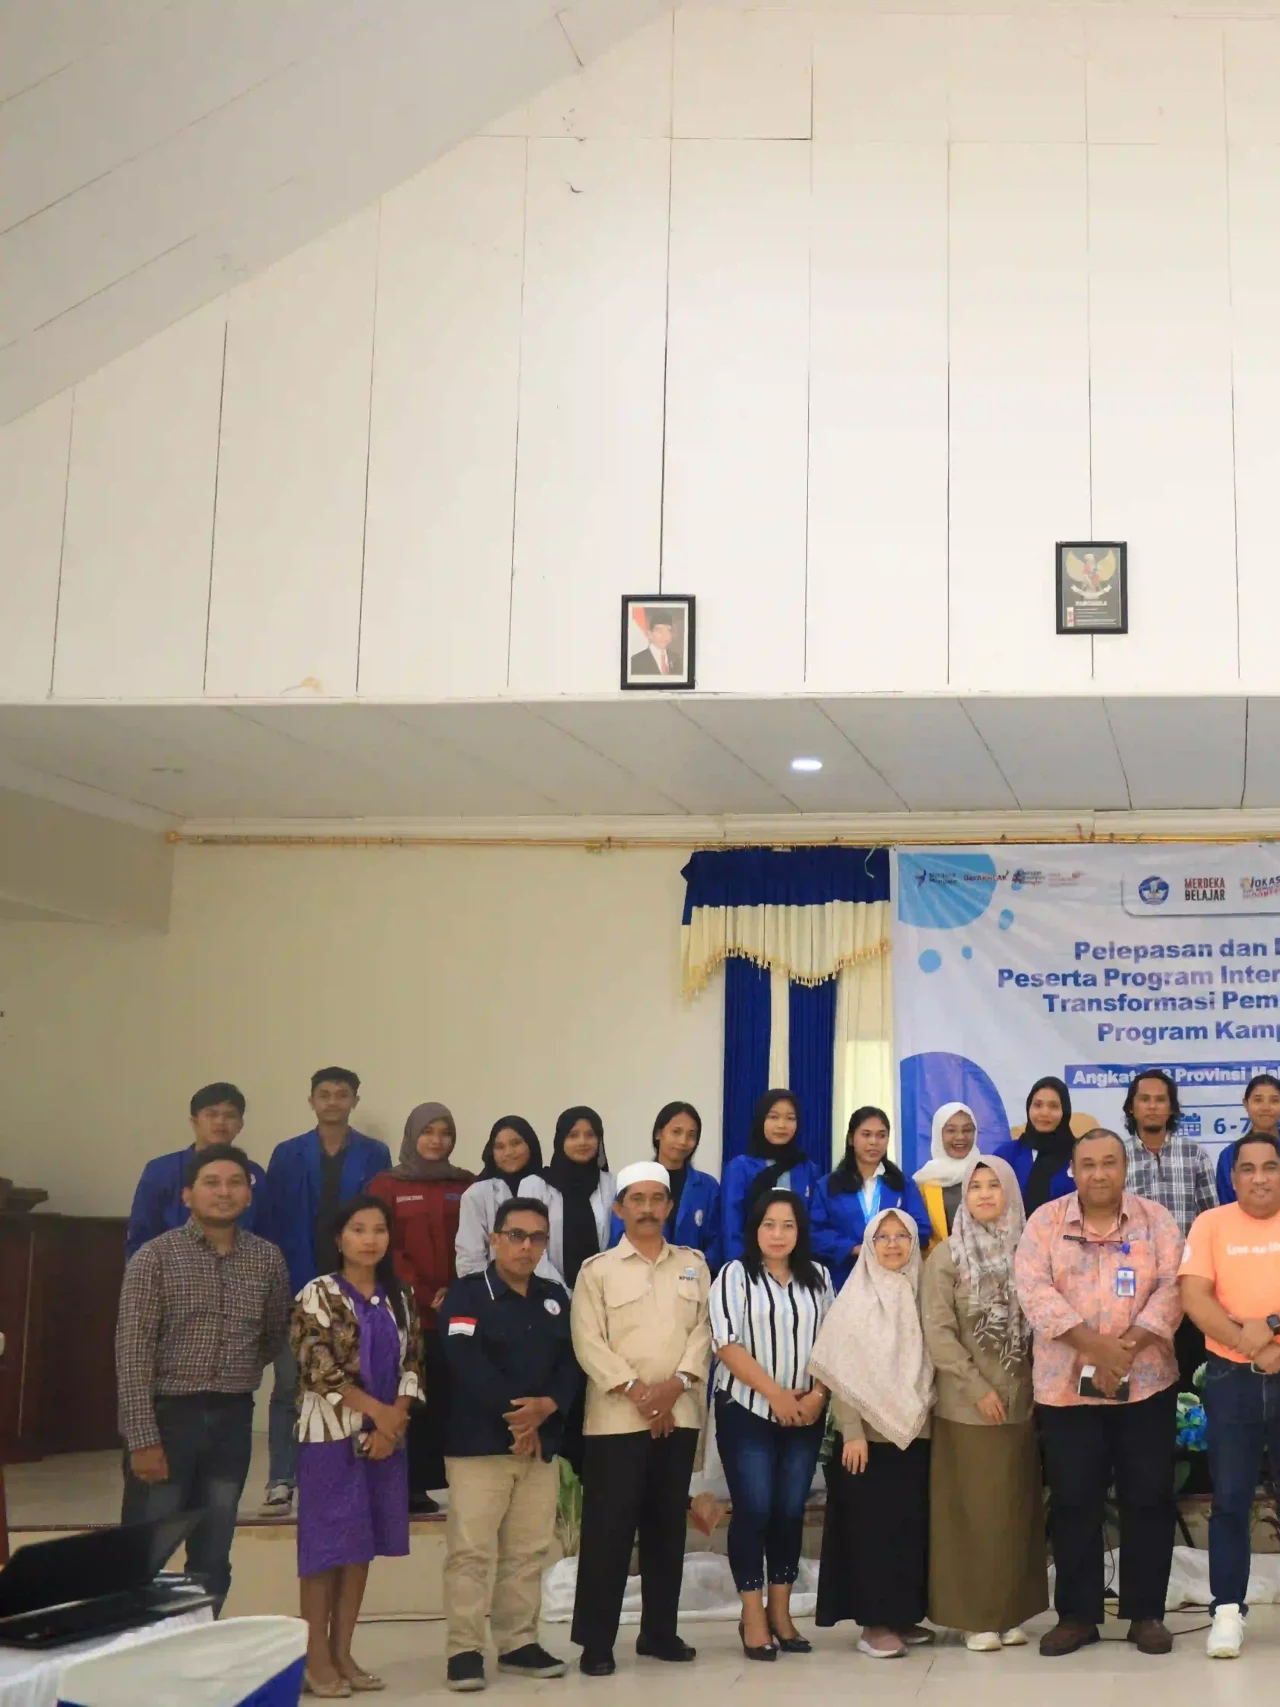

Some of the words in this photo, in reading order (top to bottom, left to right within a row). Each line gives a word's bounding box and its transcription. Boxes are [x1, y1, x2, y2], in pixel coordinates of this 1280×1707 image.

[1184, 877, 1225, 889] MERDEKA
[1184, 888, 1226, 901] BELAJAR
[1074, 940, 1213, 964] Pelepasan
[1219, 938, 1268, 957] dan
[998, 968, 1098, 988] Peserta
[1104, 968, 1214, 991] Program
[1042, 991, 1216, 1013] Transformasi
[1097, 1022, 1209, 1046] Program
[1072, 1069, 1141, 1088] Angkat
[1175, 1066, 1246, 1083] Provinsi
